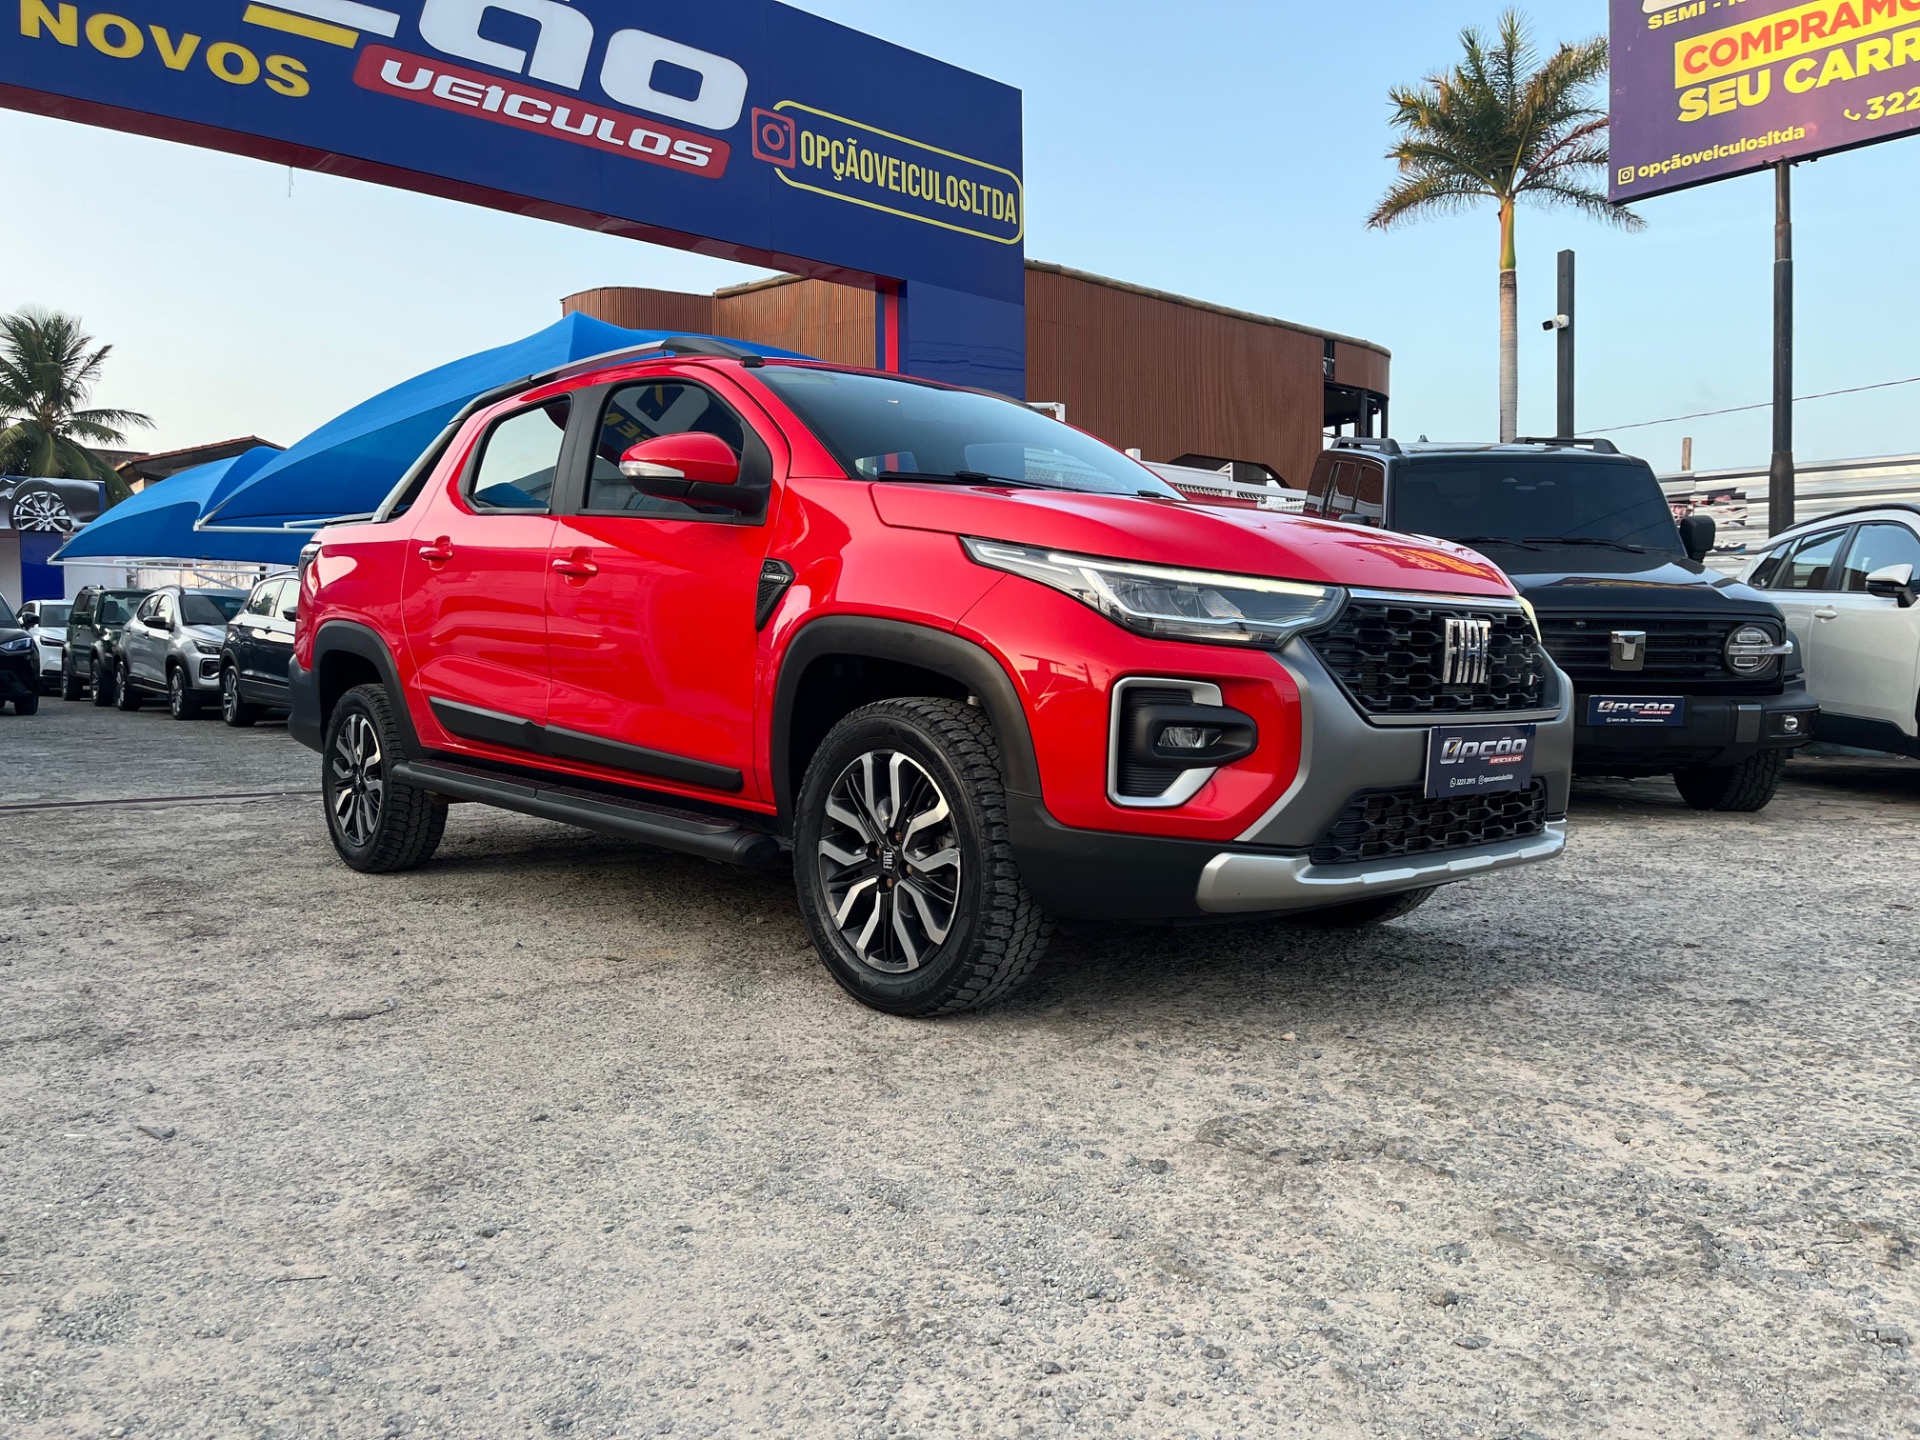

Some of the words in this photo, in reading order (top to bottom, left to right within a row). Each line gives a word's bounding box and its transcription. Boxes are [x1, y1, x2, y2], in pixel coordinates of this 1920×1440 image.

[1647, 1, 1706, 30] SEMI
[20, 0, 311, 98] NOVOS
[1678, 68, 1772, 123] SEU
[800, 130, 1017, 225] OPÇÃOVEICULOSLTDA
[1637, 126, 1806, 178] opçãoveiculosltda
[1442, 618, 1491, 684] FIAT
[883, 850, 893, 869] FIAT
